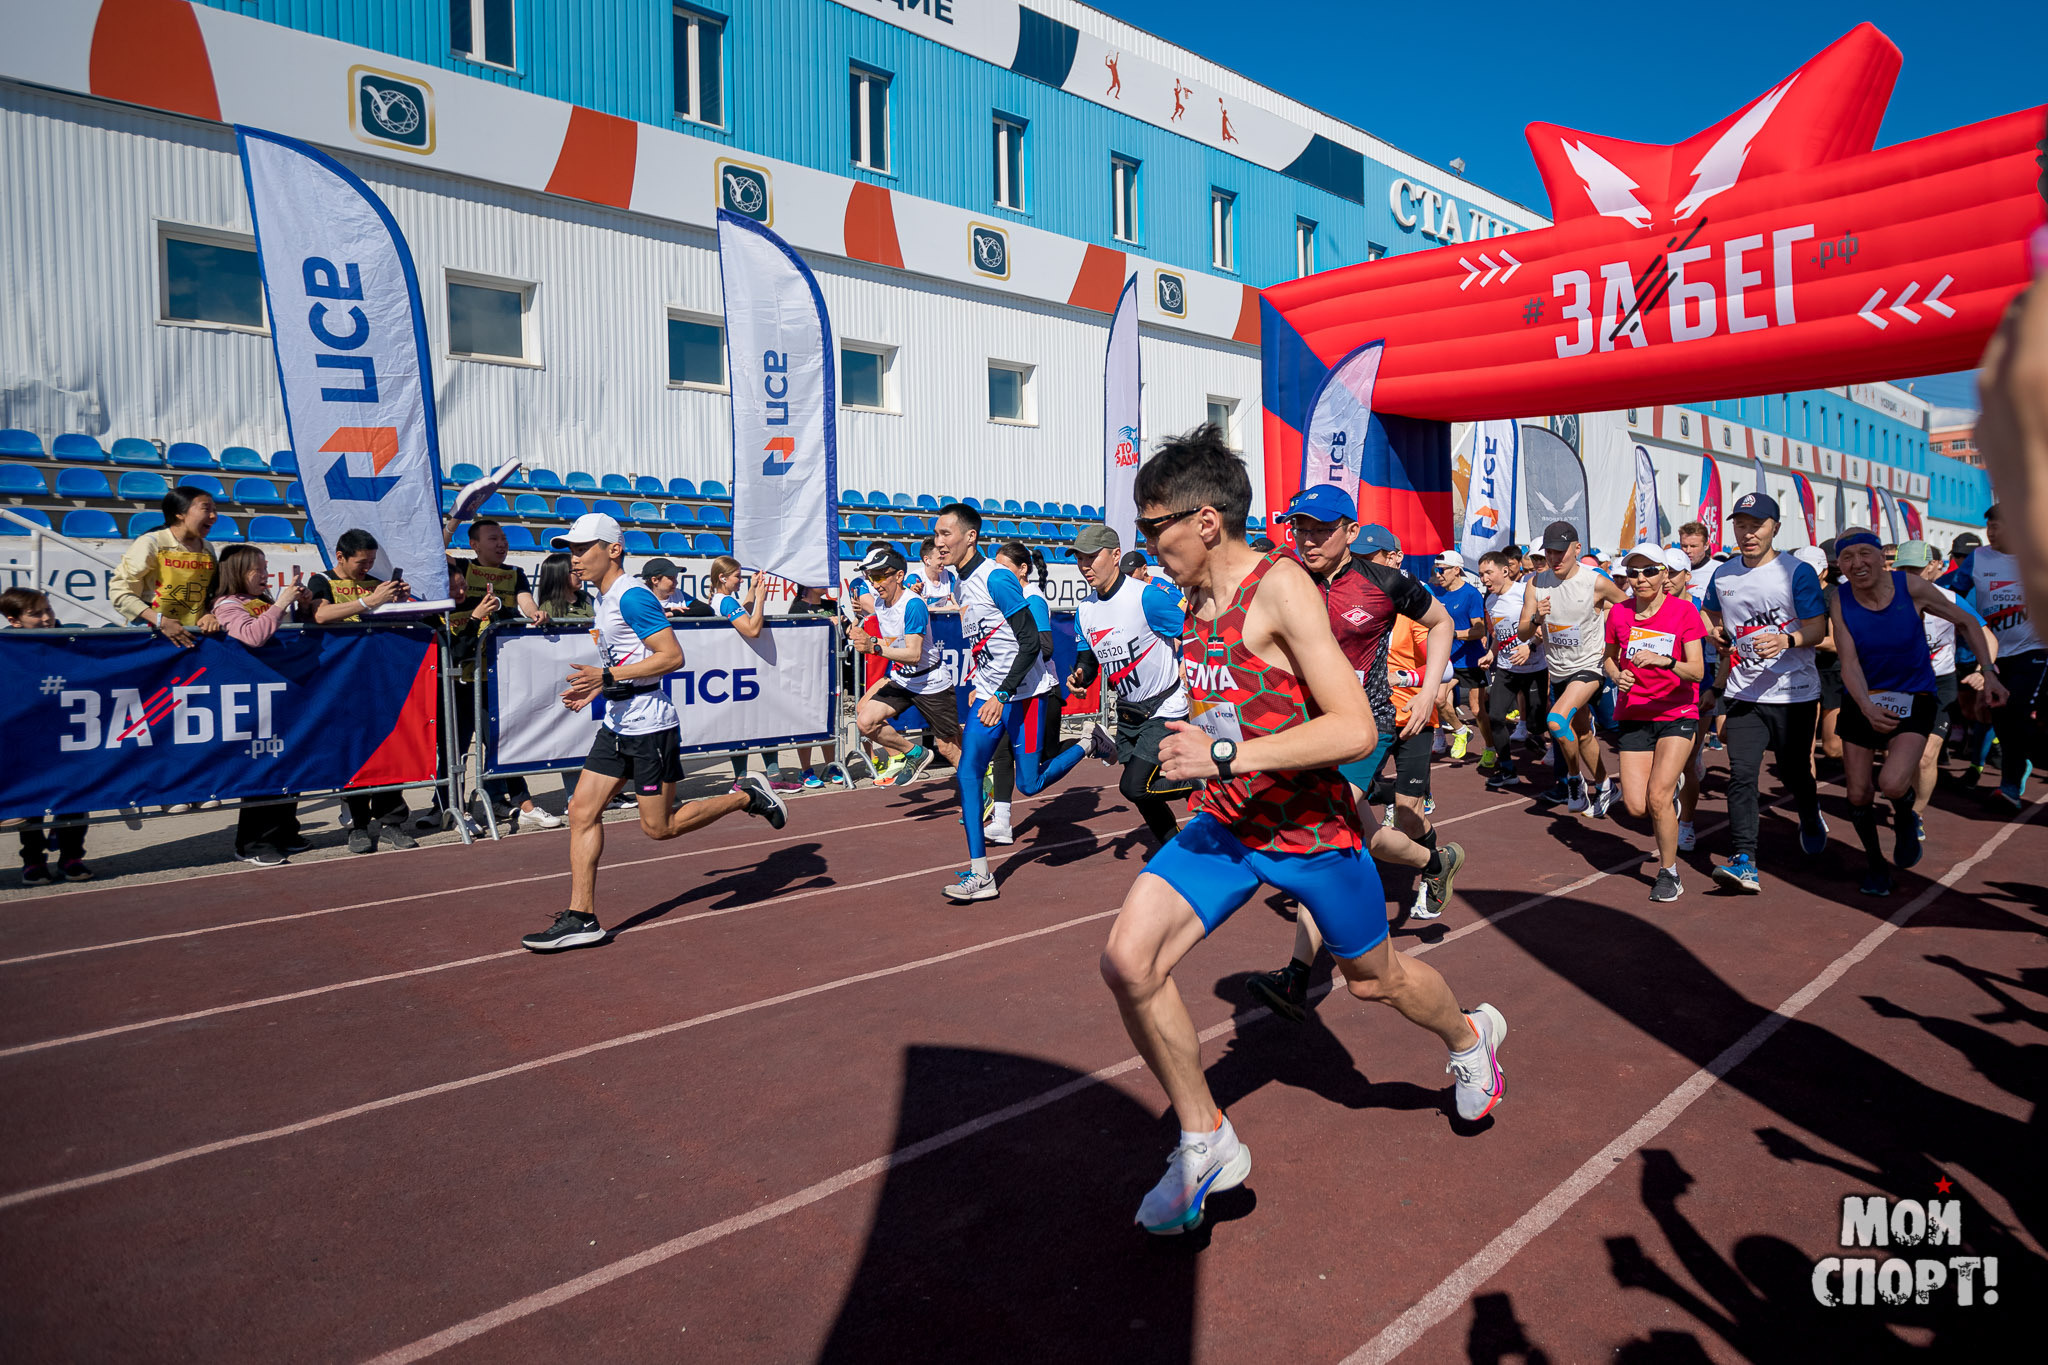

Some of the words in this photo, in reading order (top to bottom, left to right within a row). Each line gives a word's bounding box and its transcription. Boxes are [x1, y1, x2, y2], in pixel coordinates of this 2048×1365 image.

[1329, 430, 1347, 482] ПСБ
[1992, 594, 2022, 602] 05024
[1097, 645, 1124, 660] 05120
[1552, 636, 1579, 647] 00033
[662, 667, 761, 706] ПСБ
[1184, 658, 1240, 691] ENYA
